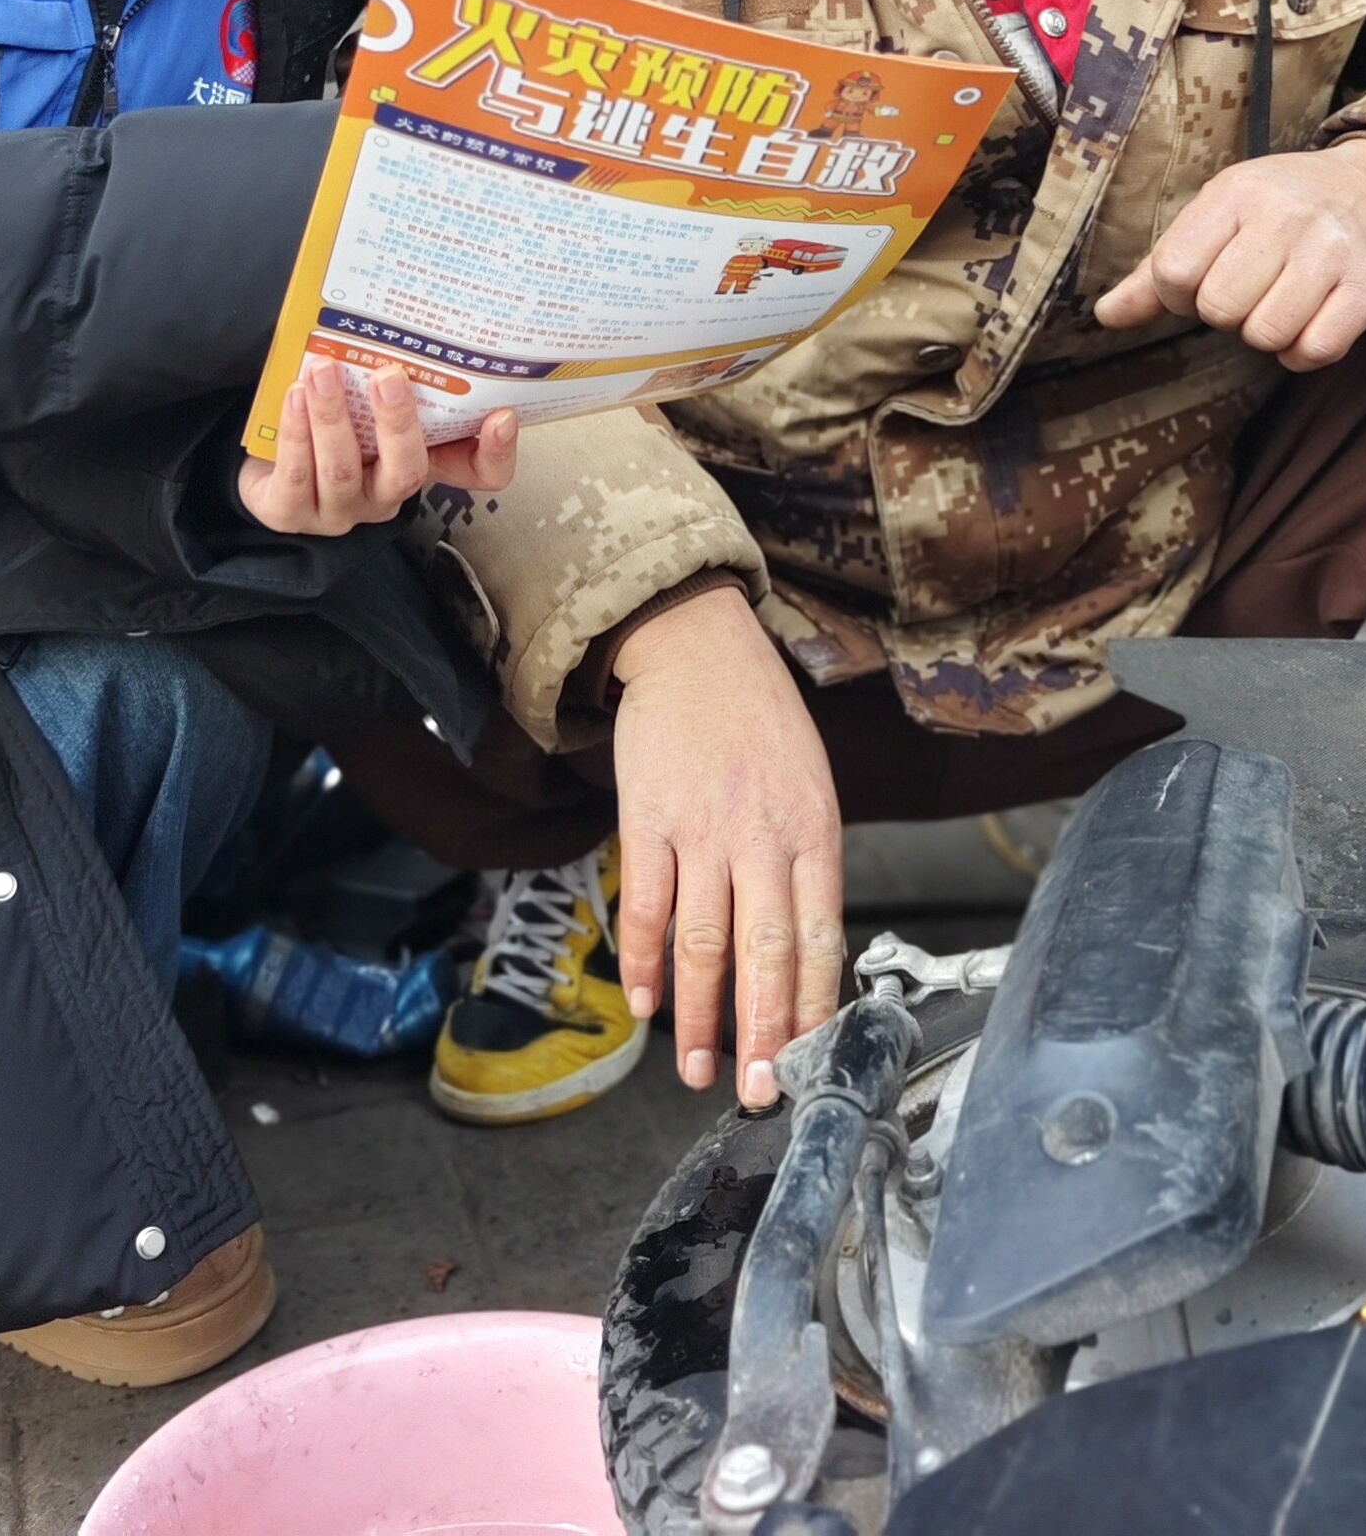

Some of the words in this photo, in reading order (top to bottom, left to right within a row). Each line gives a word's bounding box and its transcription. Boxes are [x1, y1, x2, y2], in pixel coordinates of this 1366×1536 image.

[187, 77, 252, 104] 大洋网
[394, 116, 558, 174] 火灾的预防常识
[481, 66, 903, 192] 与逃生自救
[338, 317, 531, 375] 火灾中的自救与逃生
